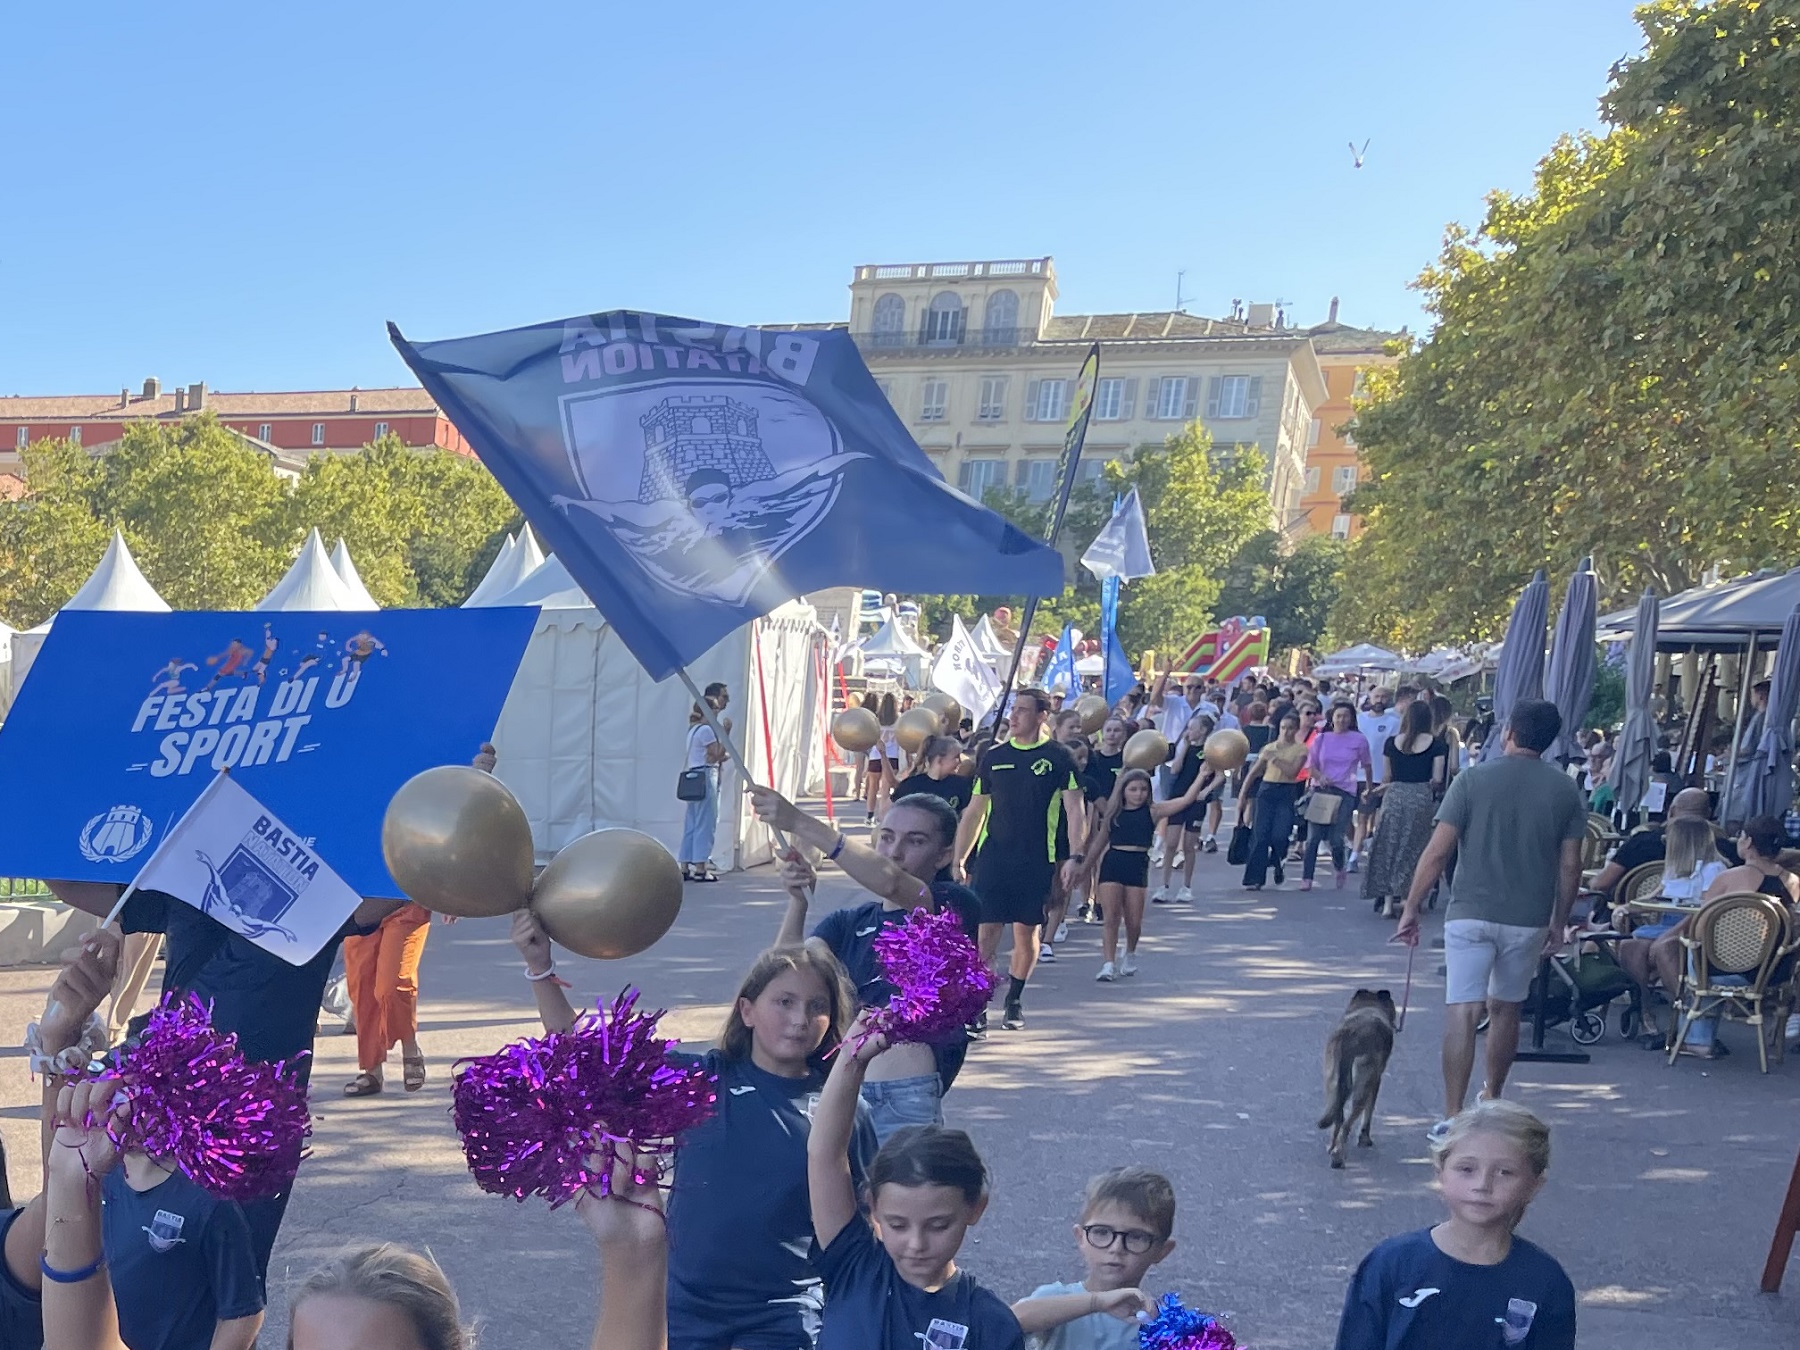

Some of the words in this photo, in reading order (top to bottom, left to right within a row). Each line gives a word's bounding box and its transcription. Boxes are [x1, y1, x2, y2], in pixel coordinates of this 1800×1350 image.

[131, 685, 261, 733] FESTA
[268, 676, 320, 718] DI
[325, 671, 361, 709] U
[150, 715, 312, 778] SPORT
[252, 815, 320, 882] BASTIA
